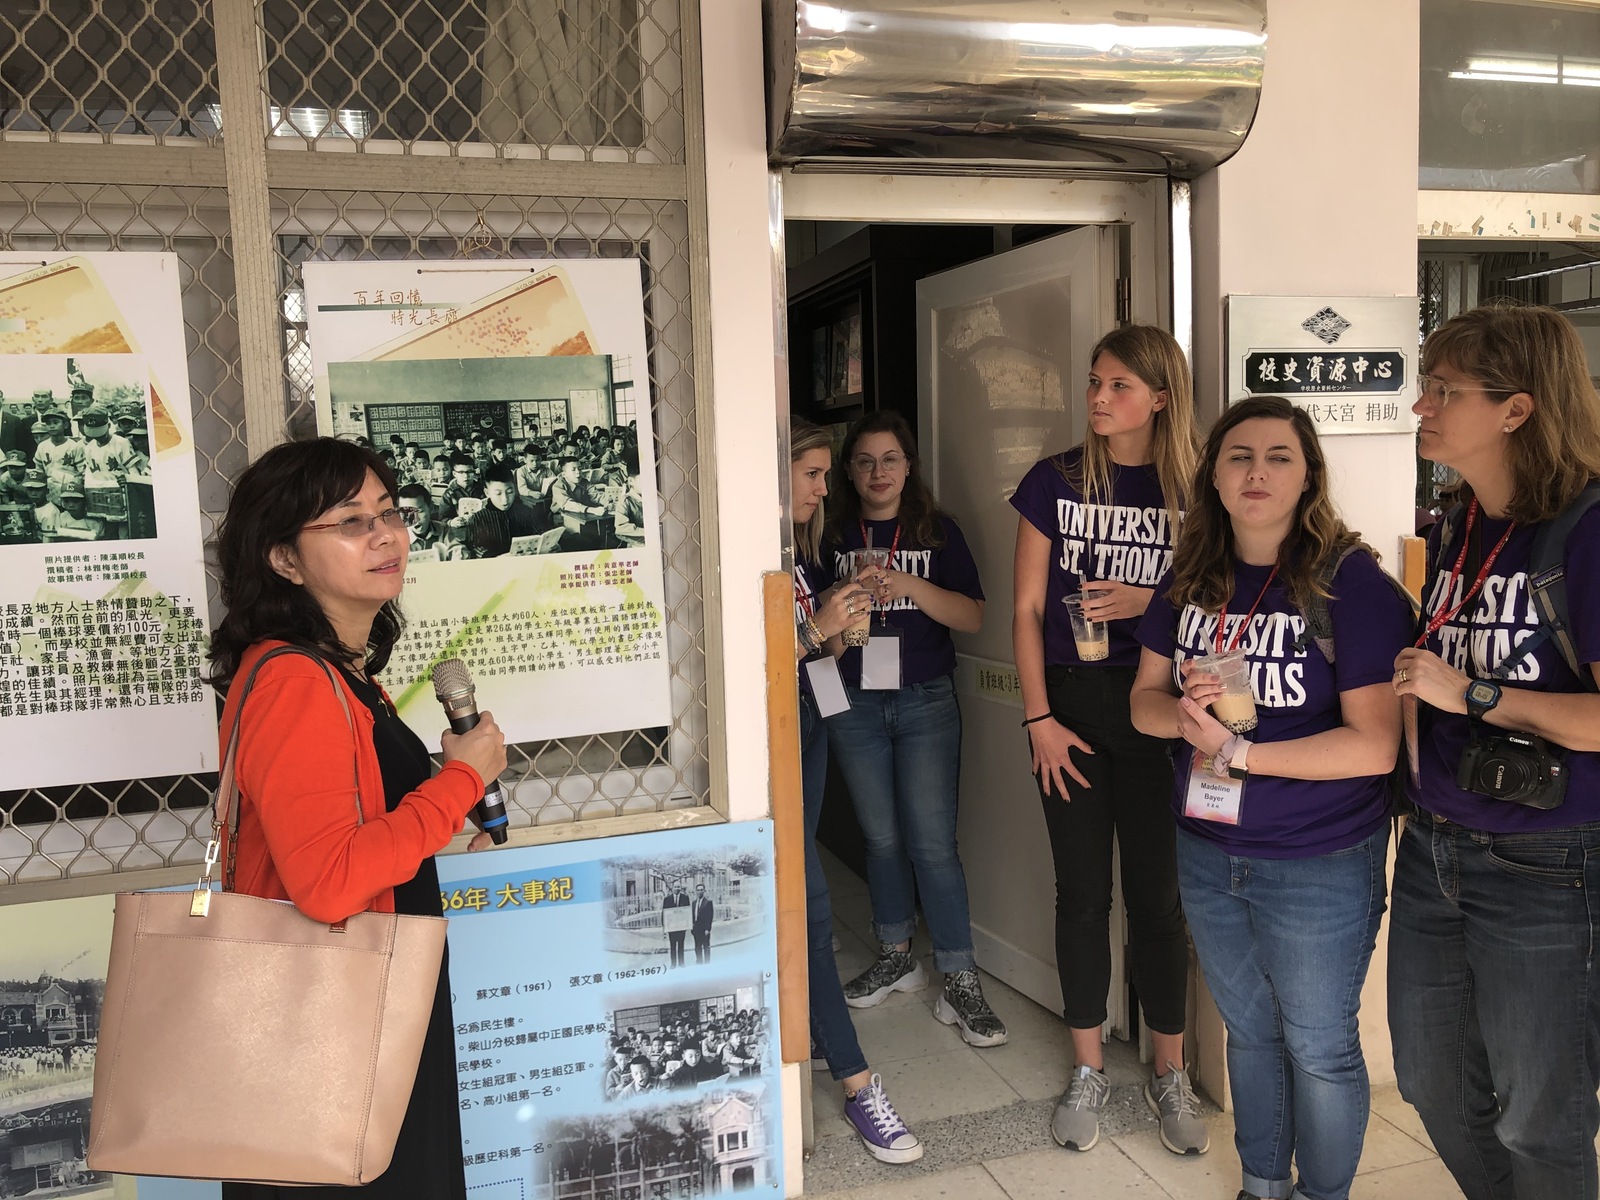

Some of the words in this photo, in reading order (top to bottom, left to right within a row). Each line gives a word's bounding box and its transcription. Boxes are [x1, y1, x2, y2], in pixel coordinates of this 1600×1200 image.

[353, 289, 423, 306] 百年回憶
[1258, 355, 1393, 384] 校史資源中心
[1298, 403, 1355, 423] 代天宮
[1366, 403, 1398, 422] 捐助
[0, 606, 195, 629] 成績。然而台前的風光，更要
[1509, 736, 1530, 746] Canon
[1495, 765, 1505, 789] Canon
[496, 876, 573, 909] 大事紀
